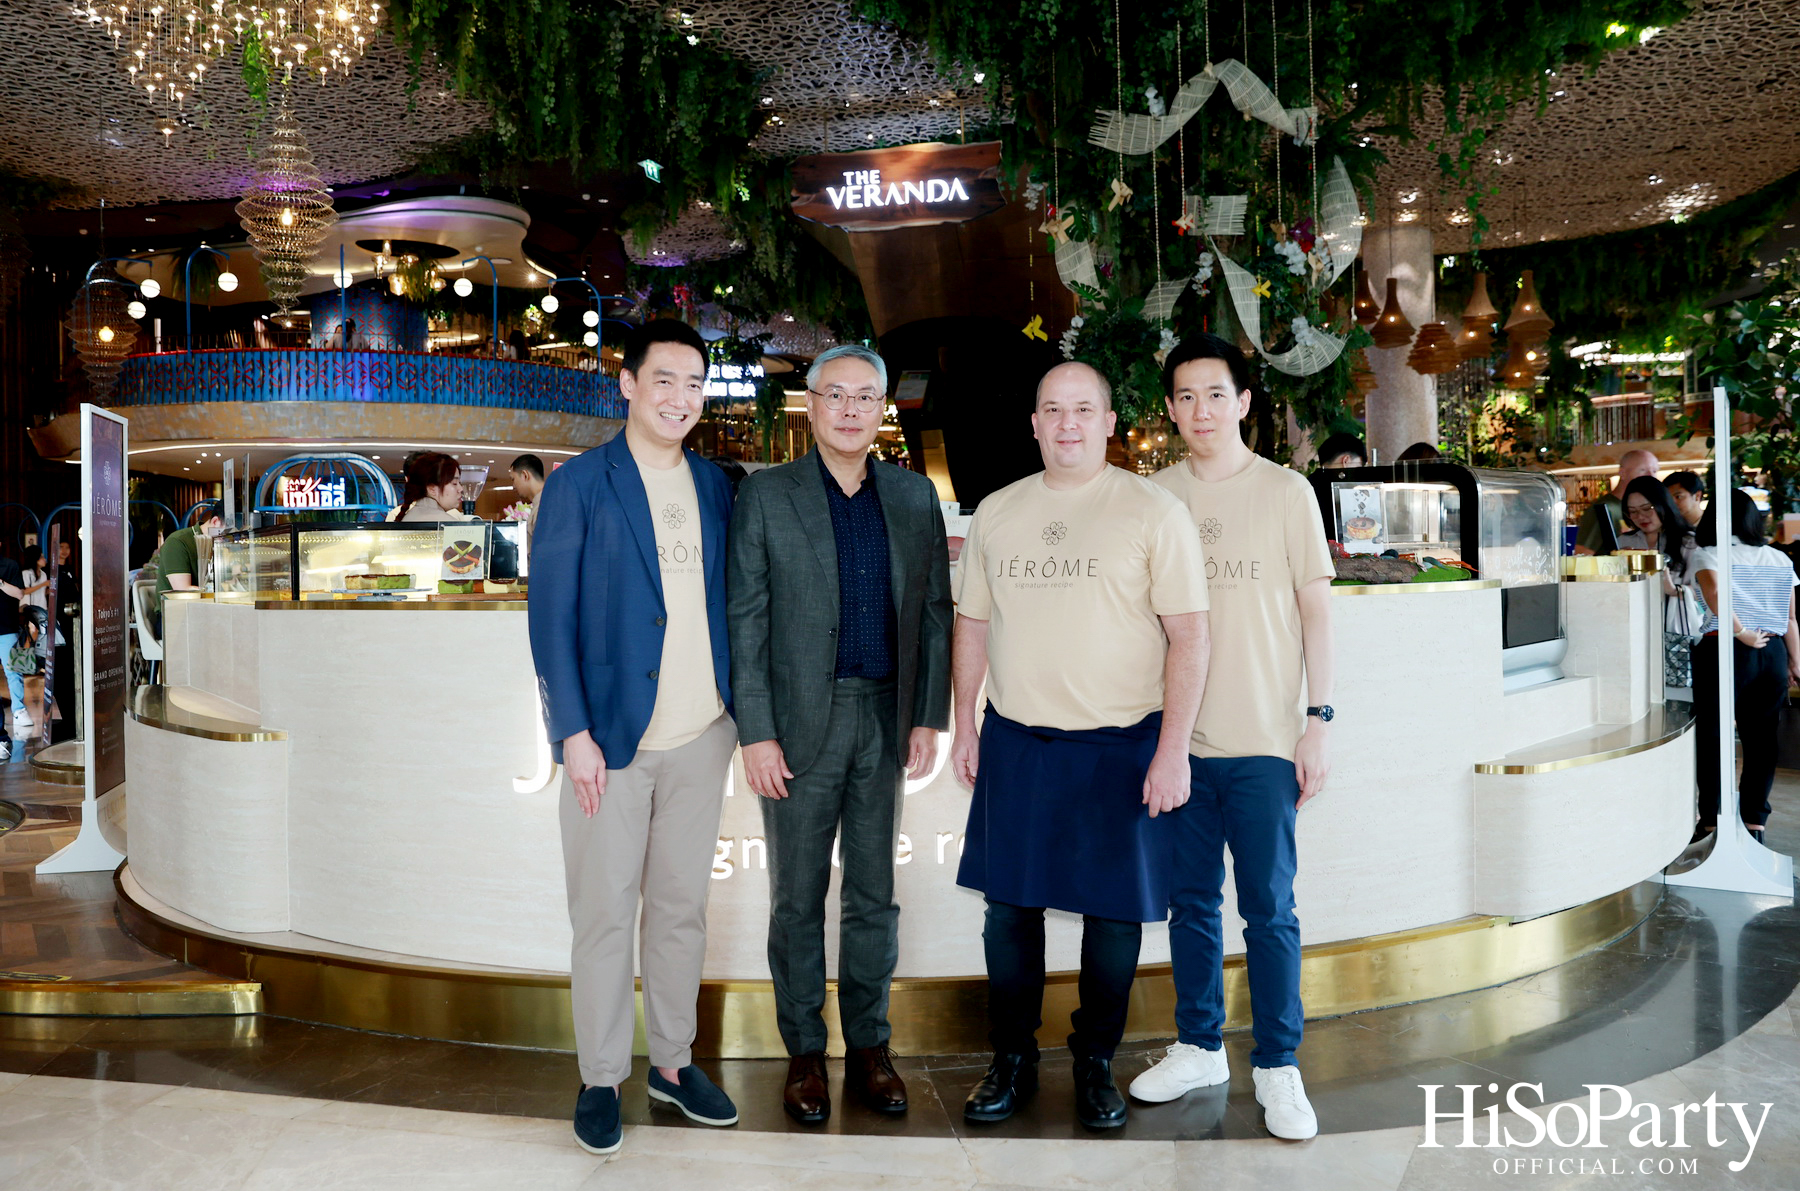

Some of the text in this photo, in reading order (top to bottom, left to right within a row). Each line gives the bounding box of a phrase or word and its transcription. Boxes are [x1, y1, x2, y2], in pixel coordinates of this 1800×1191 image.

[843, 169, 880, 186] THE
[825, 177, 970, 210] VERANDA
[92, 492, 122, 518] JÉRÔME
[657, 540, 704, 563] RÔM
[687, 567, 704, 575] recip
[997, 555, 1099, 578] JÉRÔME
[1204, 556, 1261, 580] ÔME
[1014, 581, 1074, 590] signature recipe
[98, 606, 113, 621] Tokyo's
[94, 670, 107, 682] GRAND
[108, 665, 124, 678] OPENING
